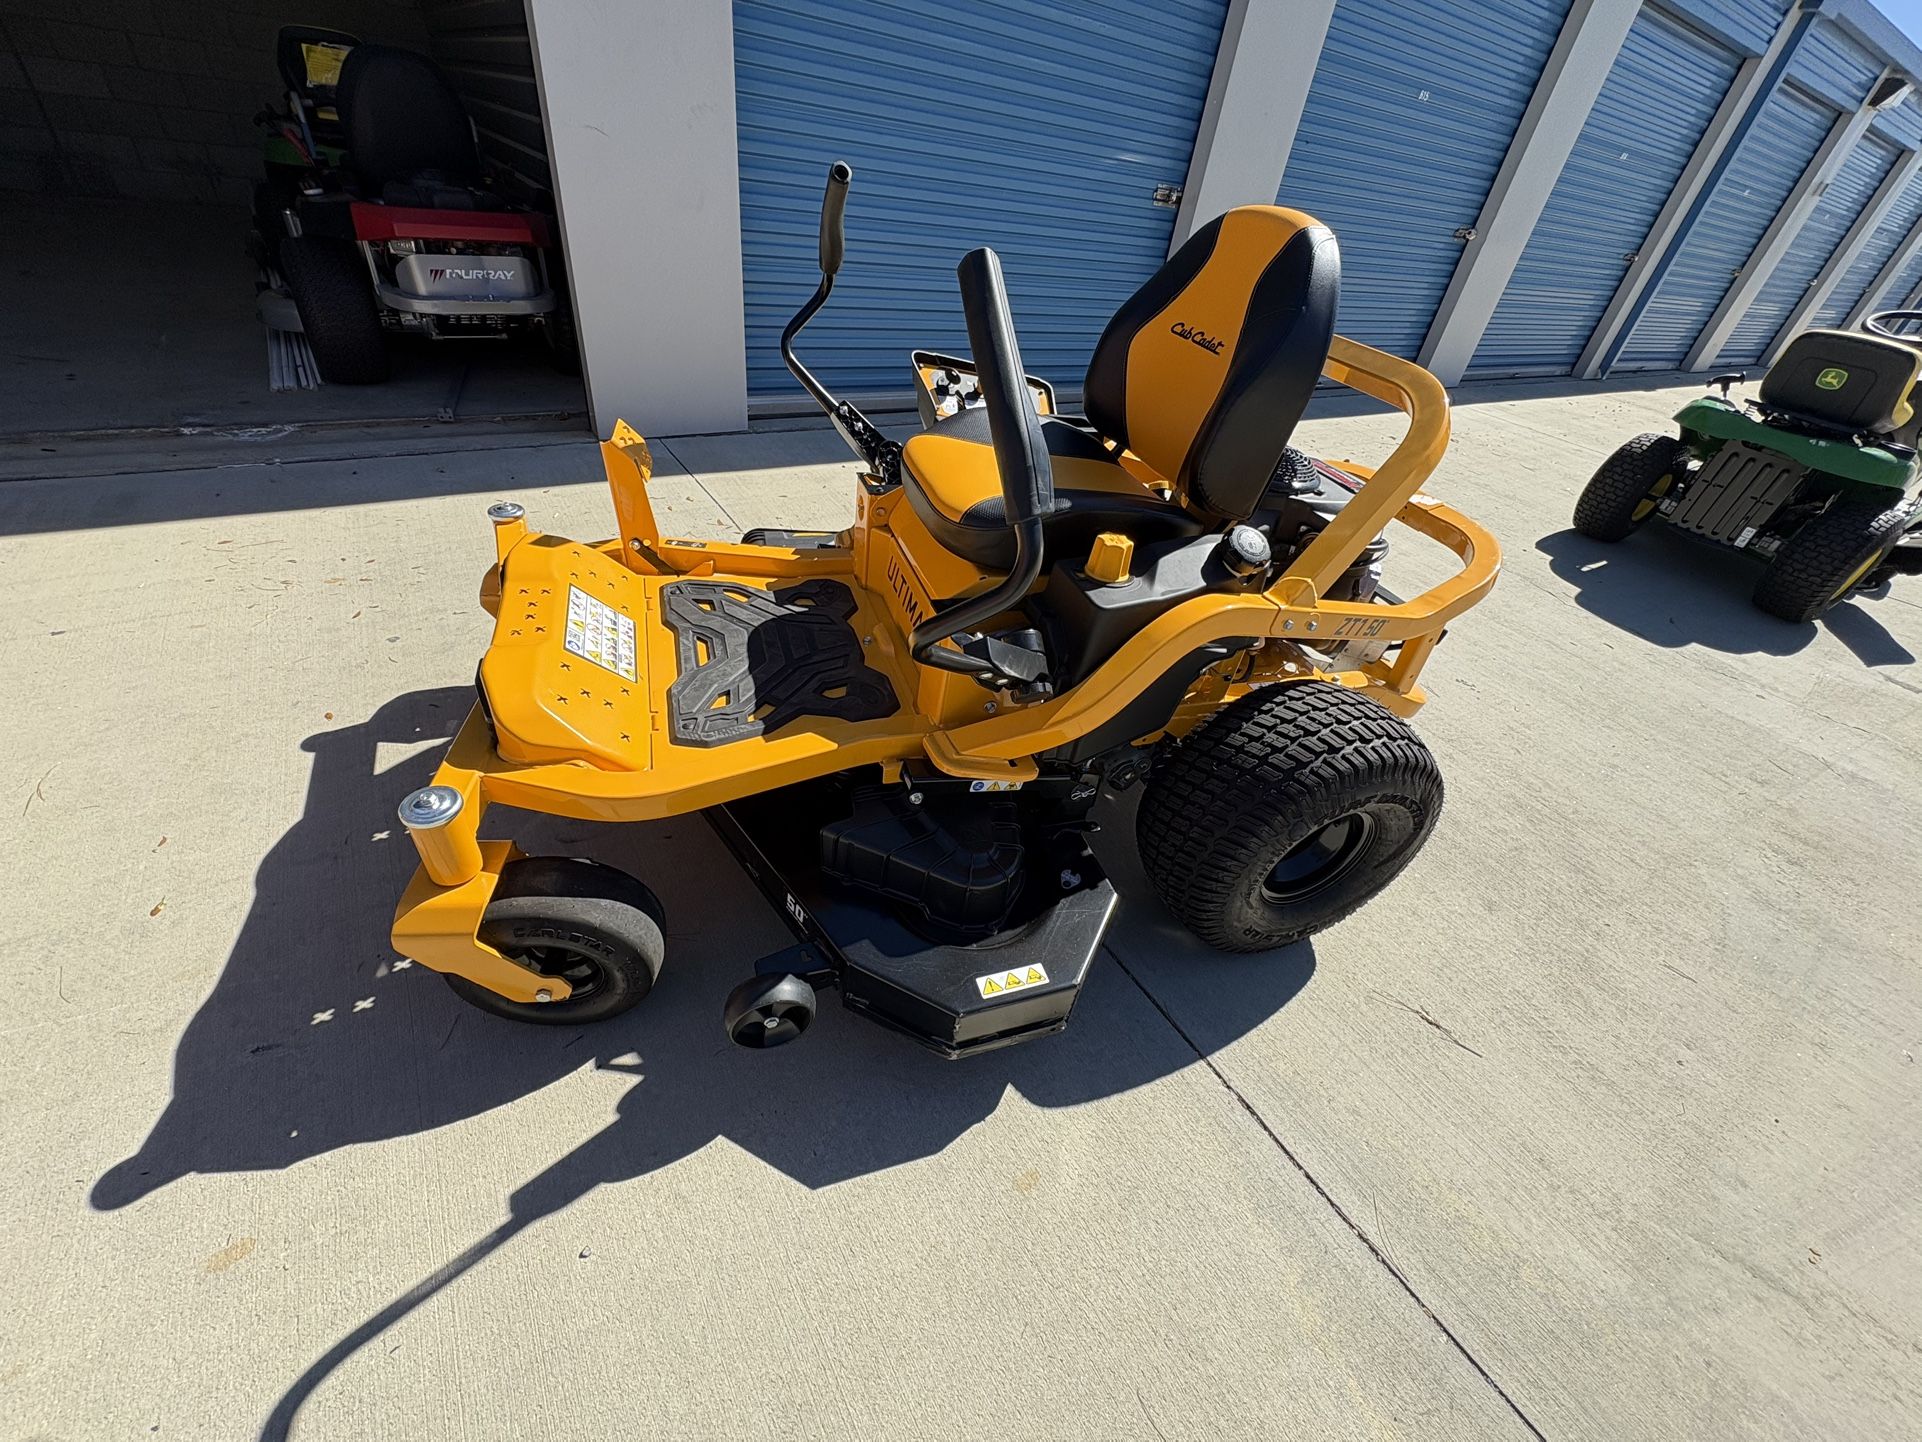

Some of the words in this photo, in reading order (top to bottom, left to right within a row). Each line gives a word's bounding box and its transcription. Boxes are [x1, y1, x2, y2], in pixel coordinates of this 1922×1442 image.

[445, 268, 515, 280] MURRAY
[1170, 322, 1195, 341] Cub
[1191, 331, 1225, 355] Cadet
[887, 555, 923, 628] ULTIMA
[1333, 617, 1368, 637] ZT1
[513, 926, 616, 958] CARLSTAR
